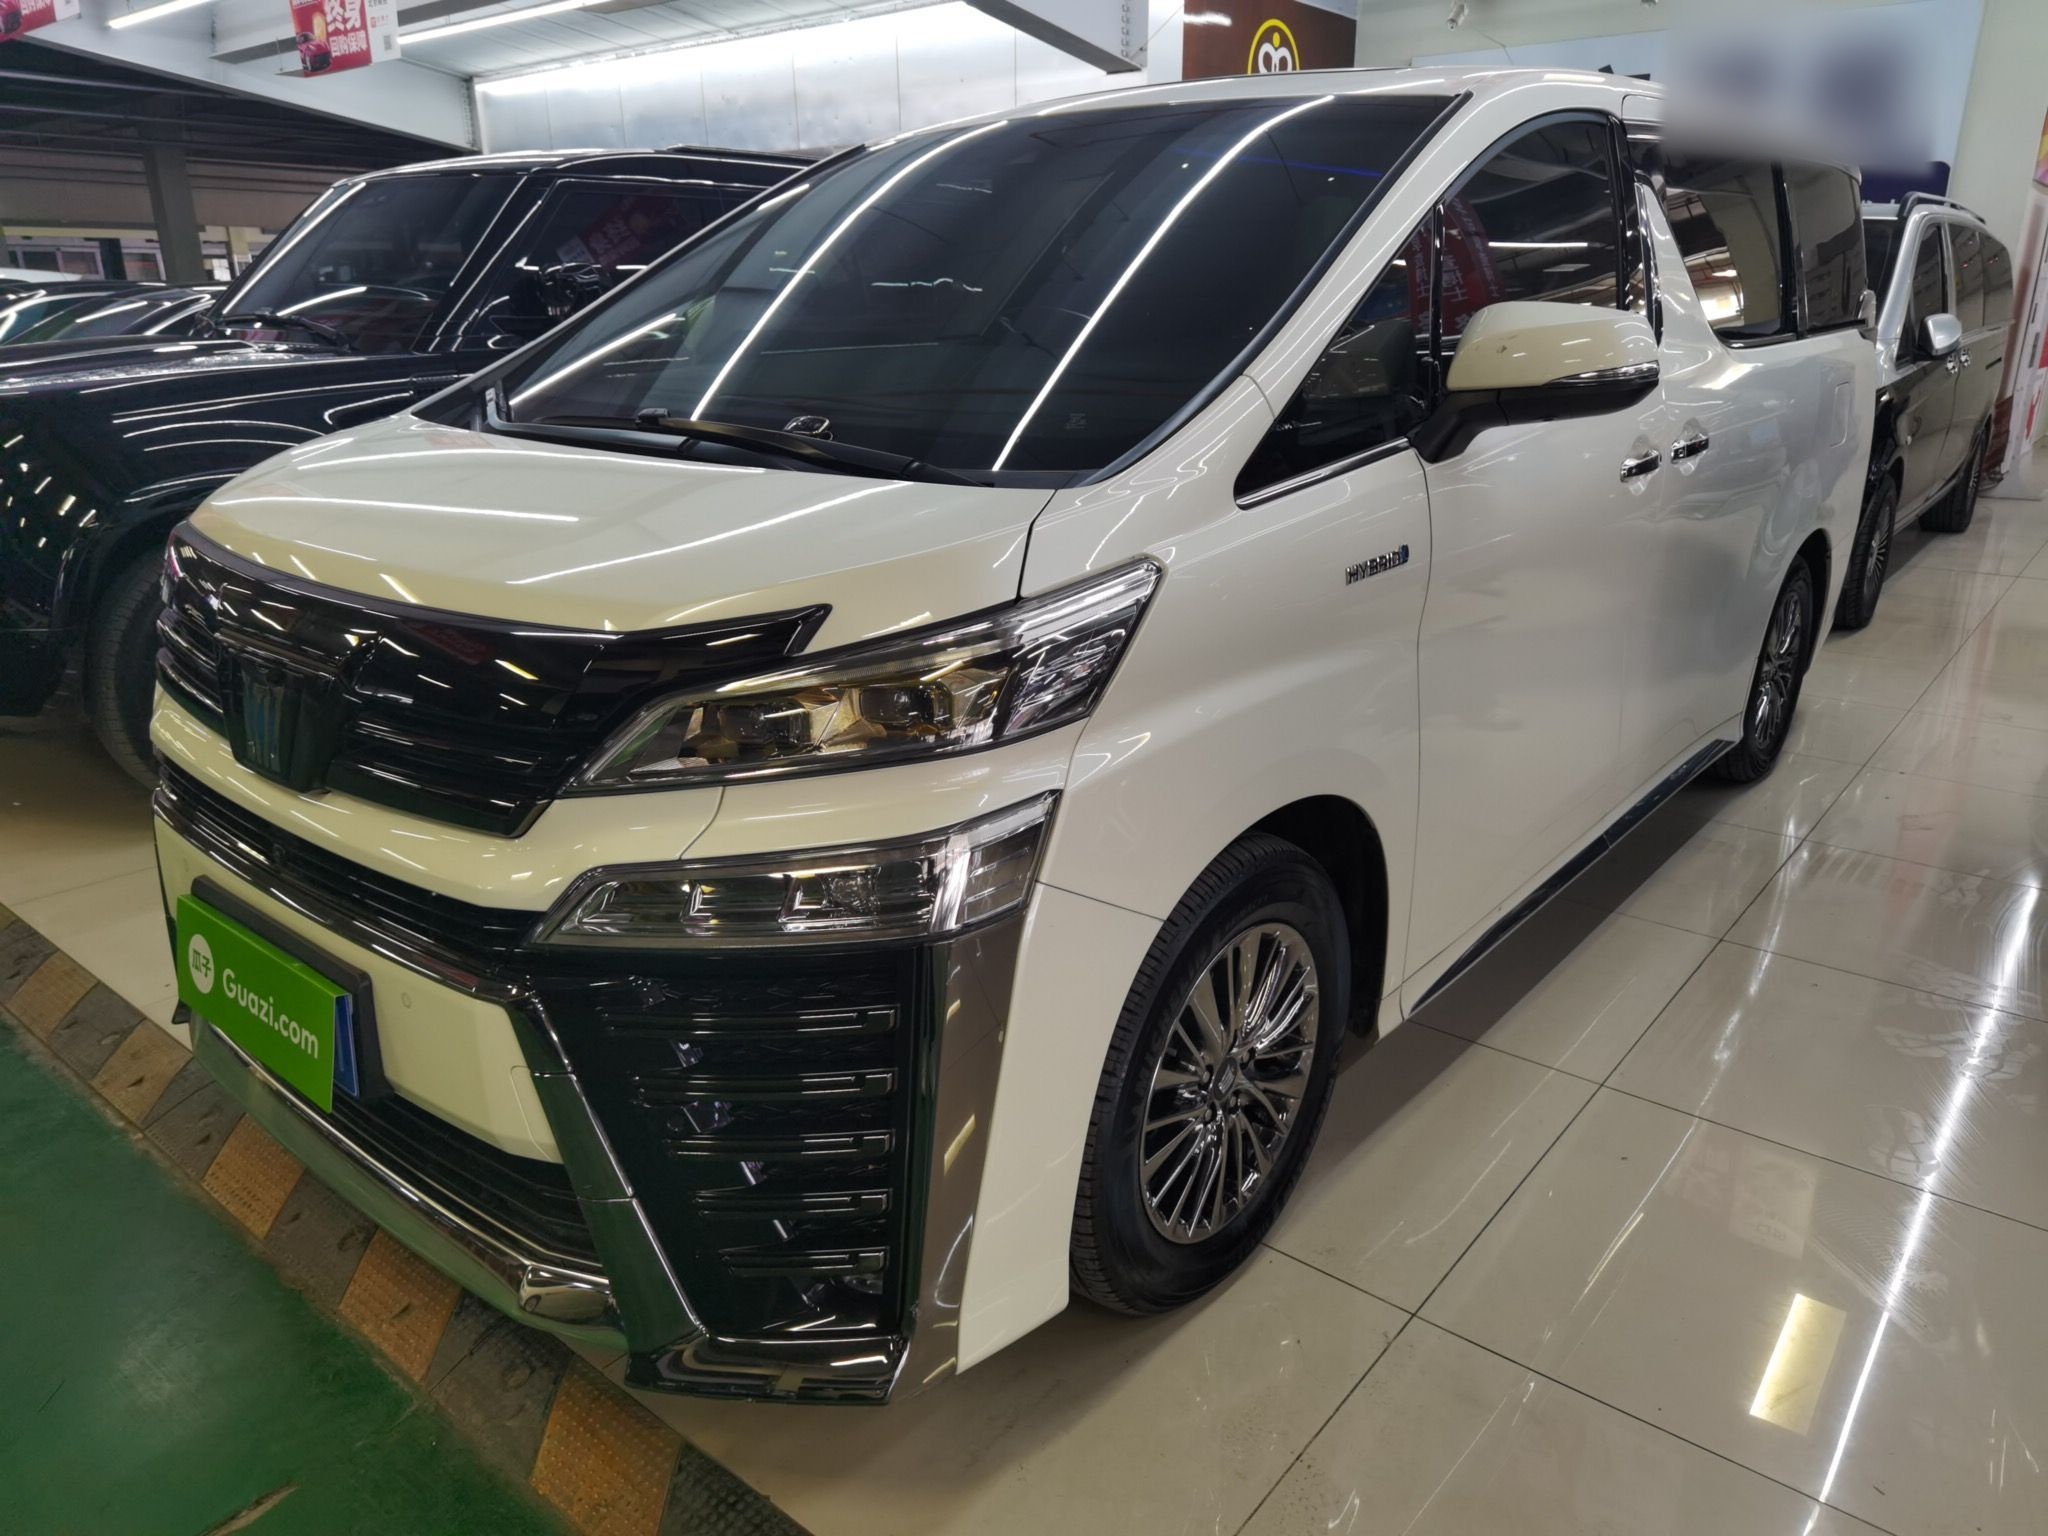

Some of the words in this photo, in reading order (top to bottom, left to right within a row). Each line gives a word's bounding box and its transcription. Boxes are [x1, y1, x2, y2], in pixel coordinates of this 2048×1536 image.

[1346, 551, 1400, 585] HYBRID
[192, 949, 212, 979] 瓜子
[222, 968, 319, 1059] Guazi.com
